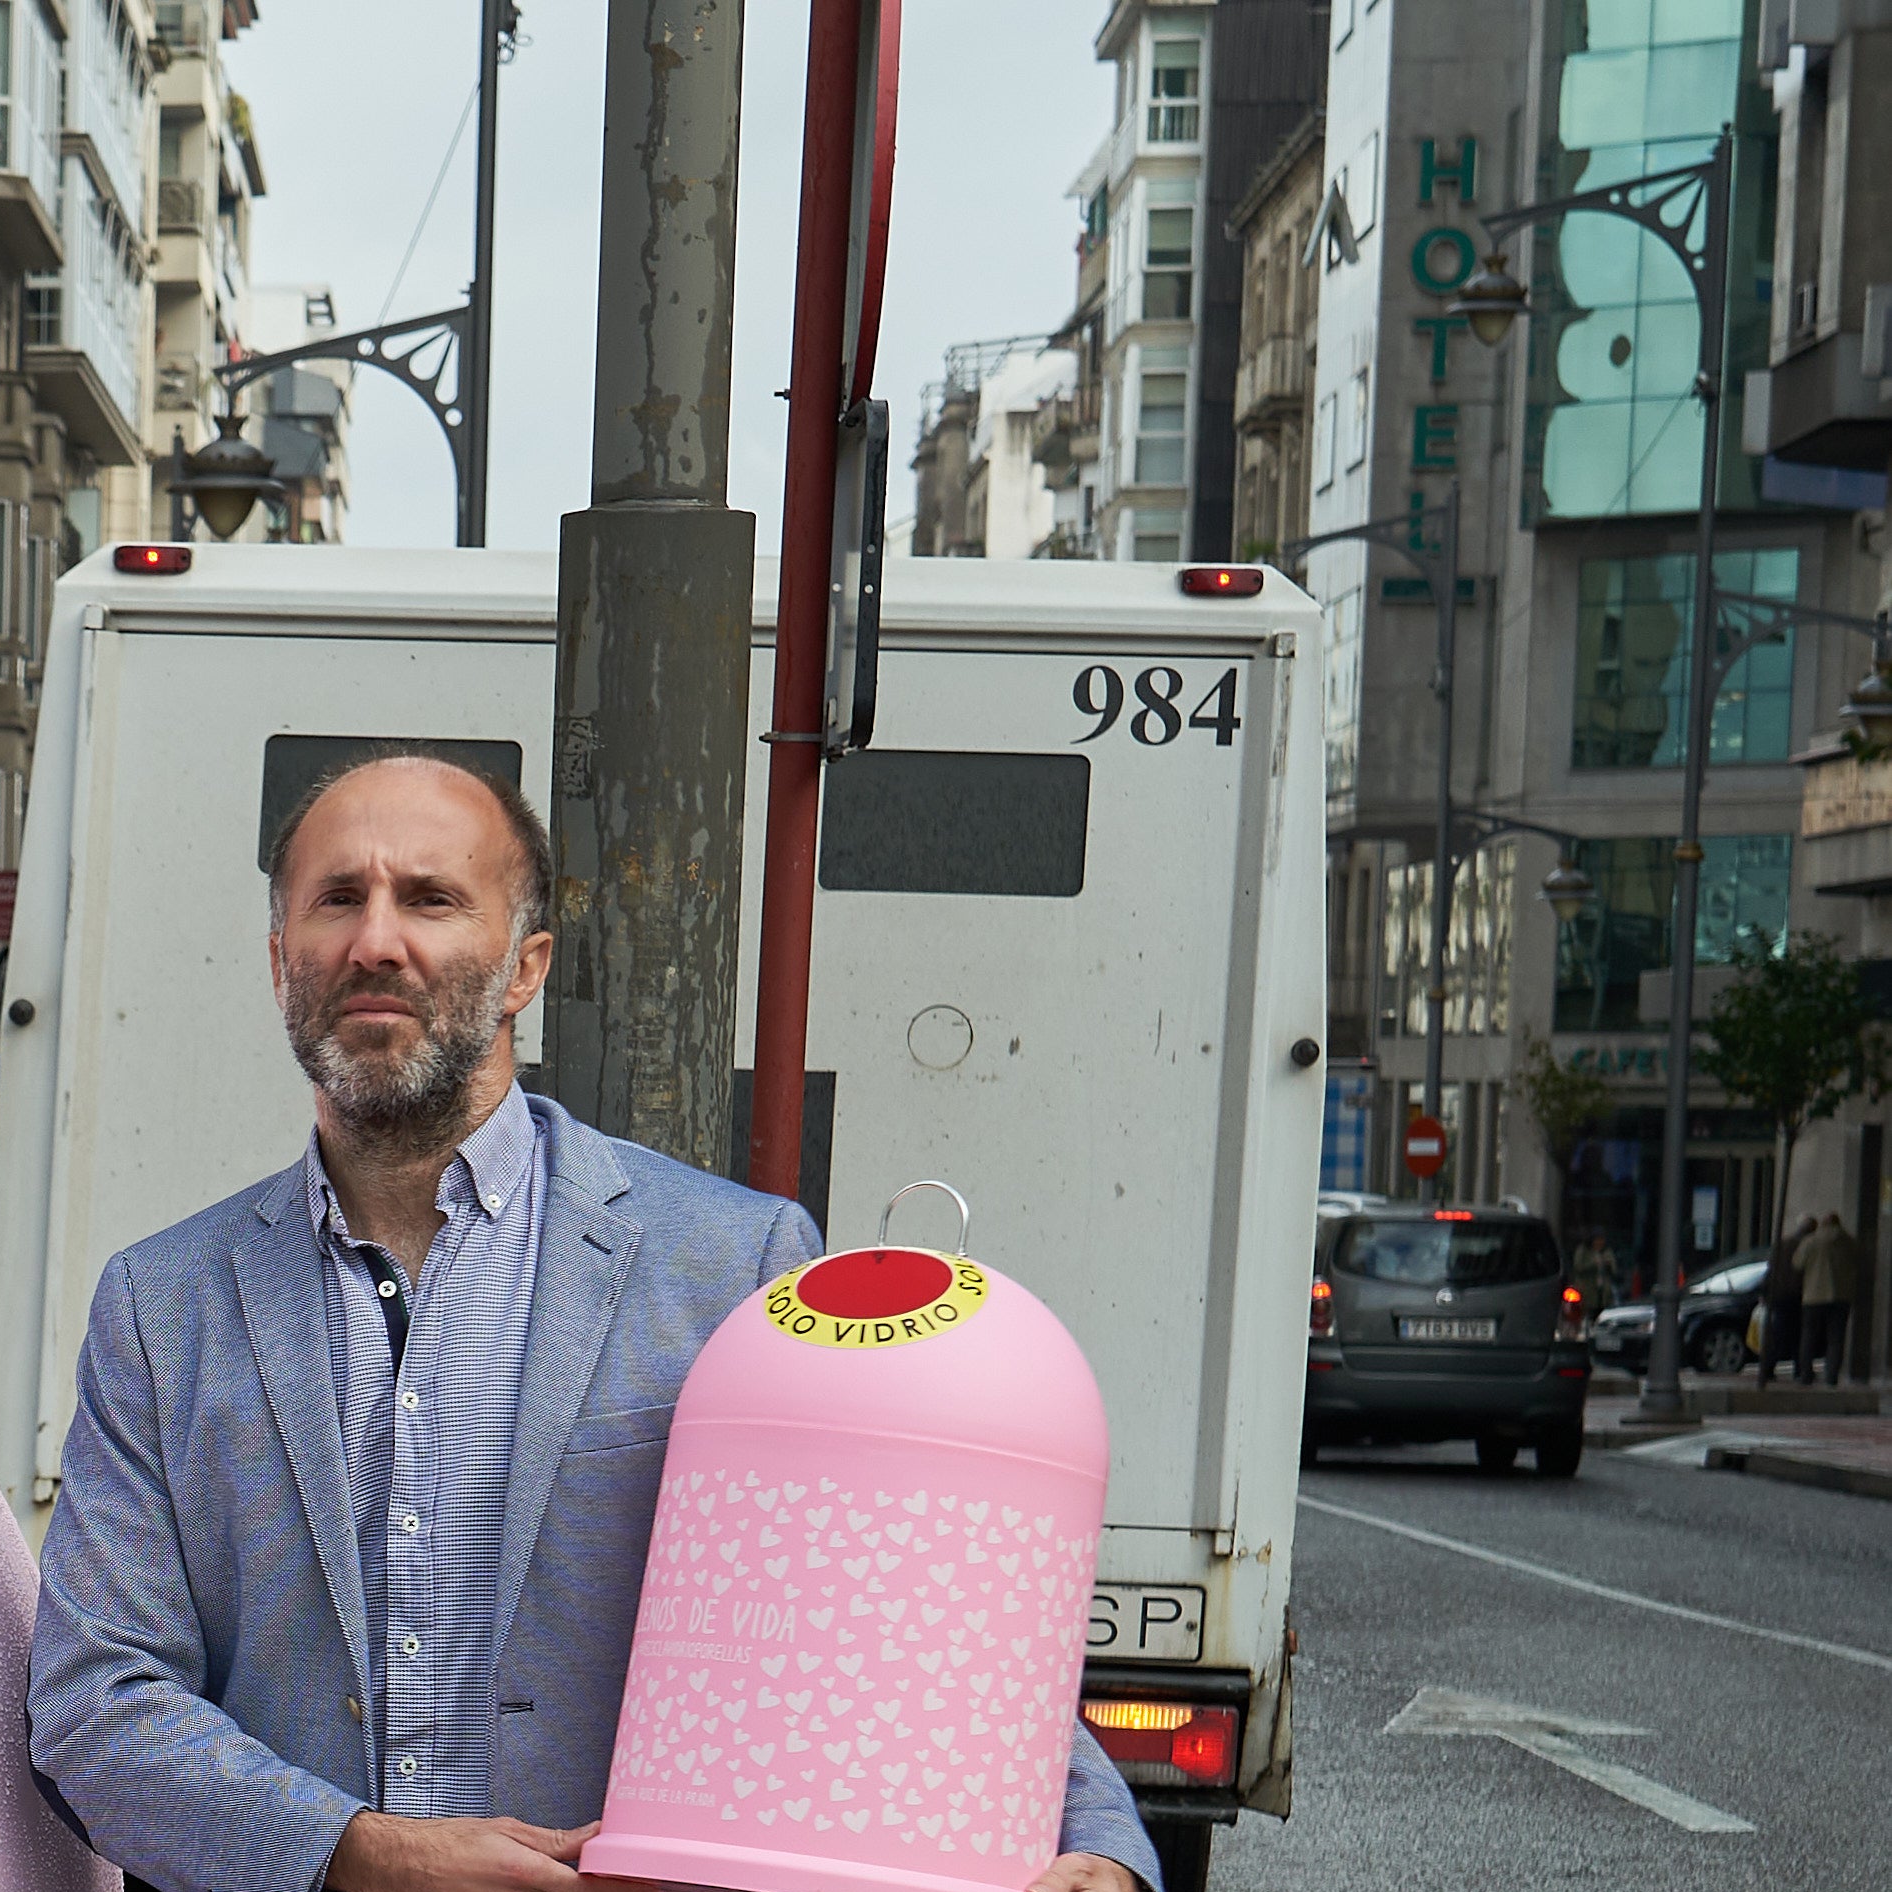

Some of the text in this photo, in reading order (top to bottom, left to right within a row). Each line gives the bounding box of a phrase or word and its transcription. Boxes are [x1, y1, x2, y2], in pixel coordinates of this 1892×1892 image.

[1407, 136, 1478, 553] HOTEL
[1069, 664, 1242, 747] 984
[767, 1285, 958, 1343] SOLO VIDRIO
[687, 1596, 720, 1635] DE
[732, 1600, 797, 1644] VIDA
